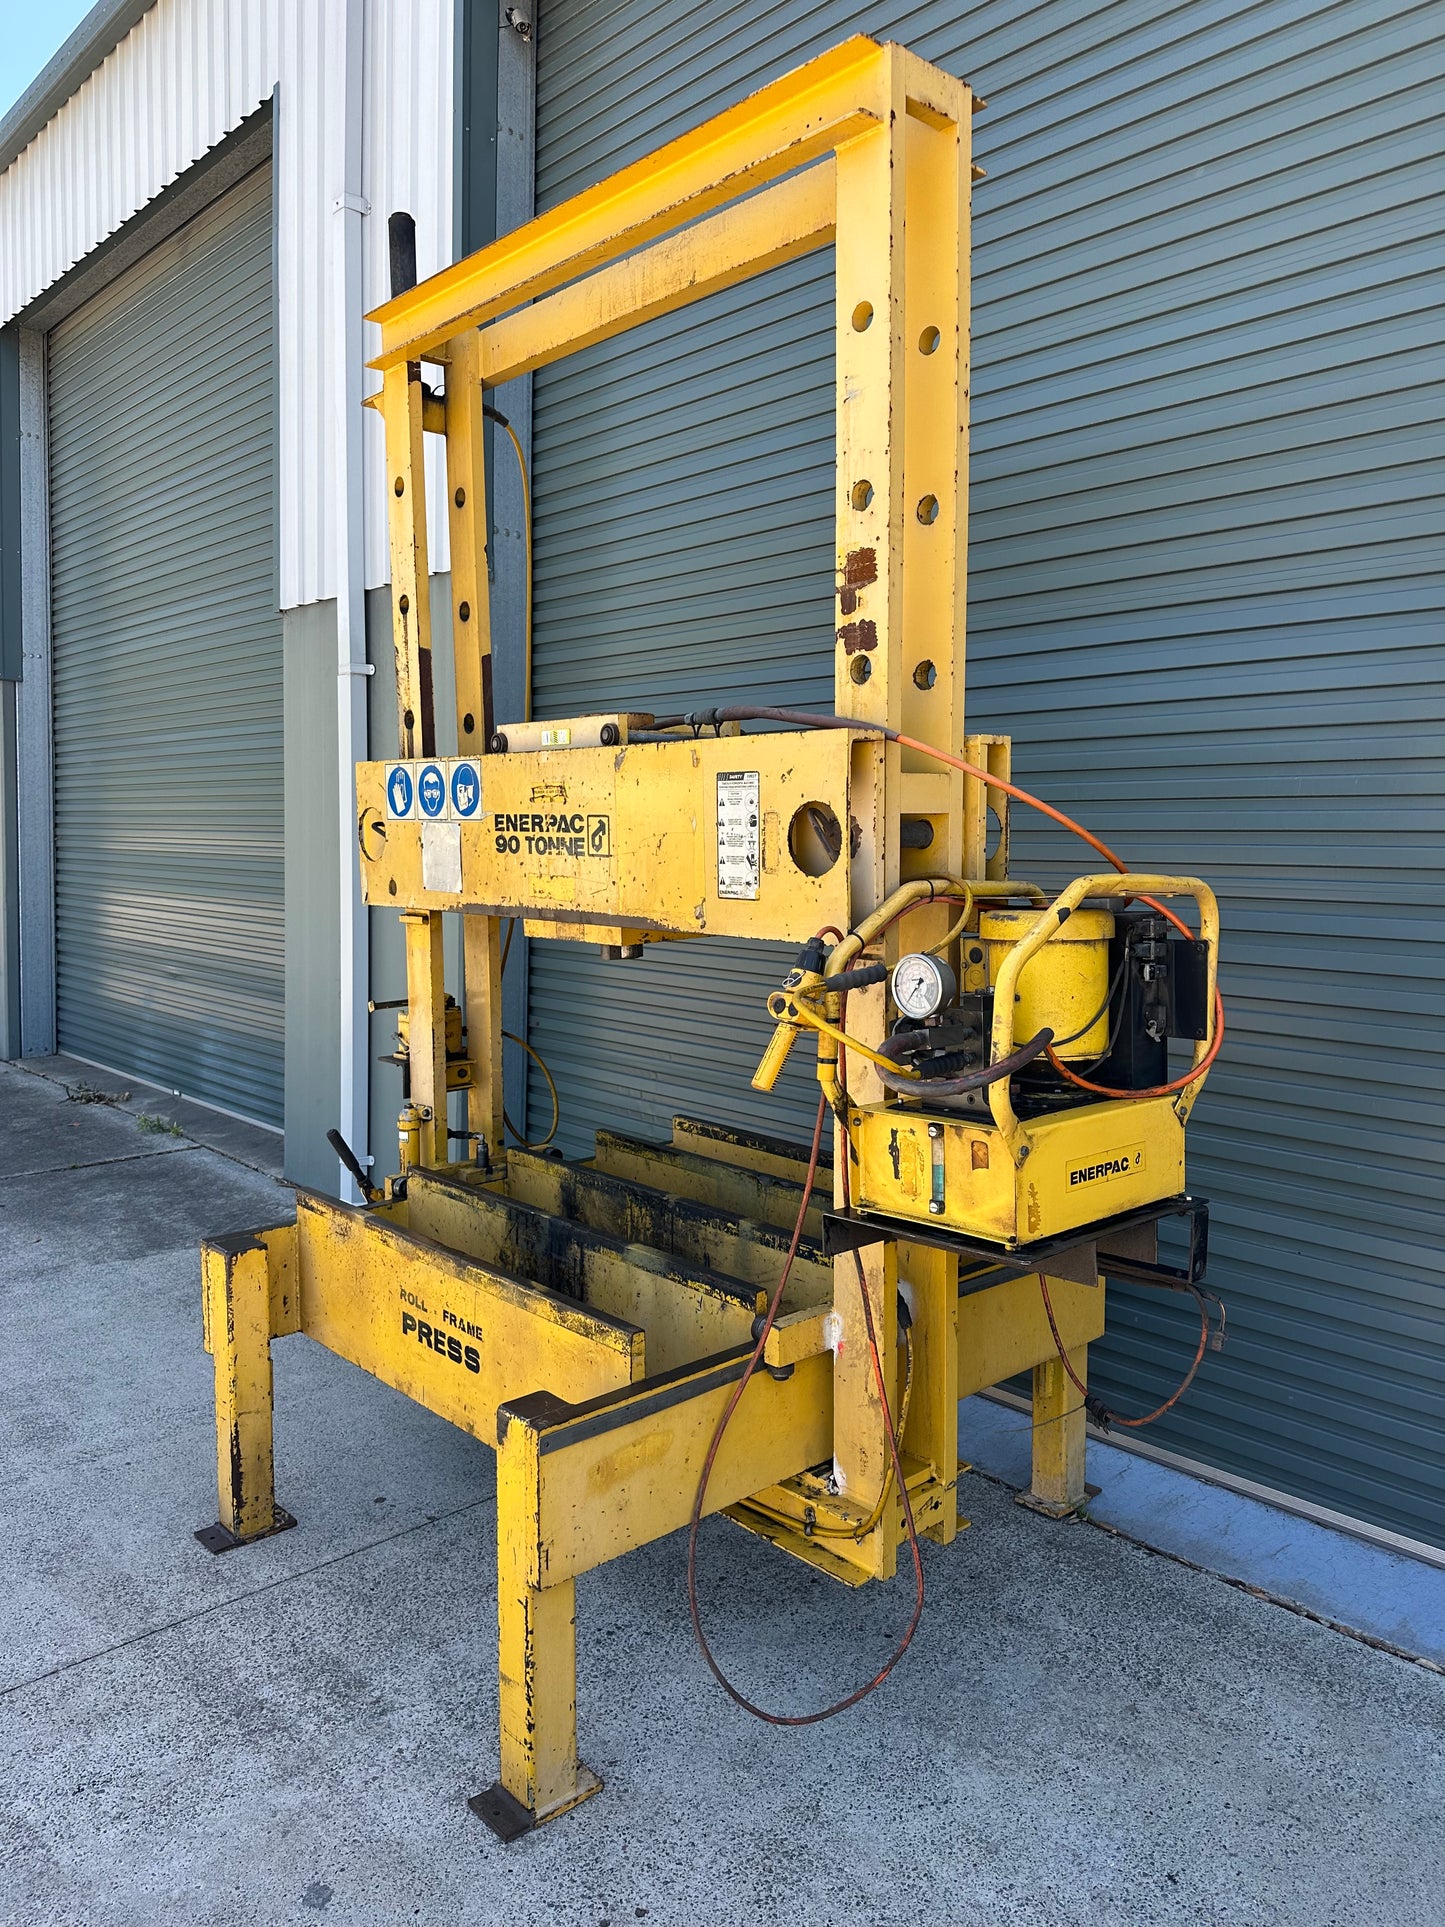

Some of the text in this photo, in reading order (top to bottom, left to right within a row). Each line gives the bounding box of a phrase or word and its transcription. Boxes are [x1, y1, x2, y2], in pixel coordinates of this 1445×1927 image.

[494, 813, 585, 834] ENERPAC
[495, 836, 586, 857] 90 TONNE
[1070, 1156, 1129, 1186] ENERPAC
[399, 1288, 483, 1342] ROLL FRAME
[402, 1311, 481, 1375] PRESS
